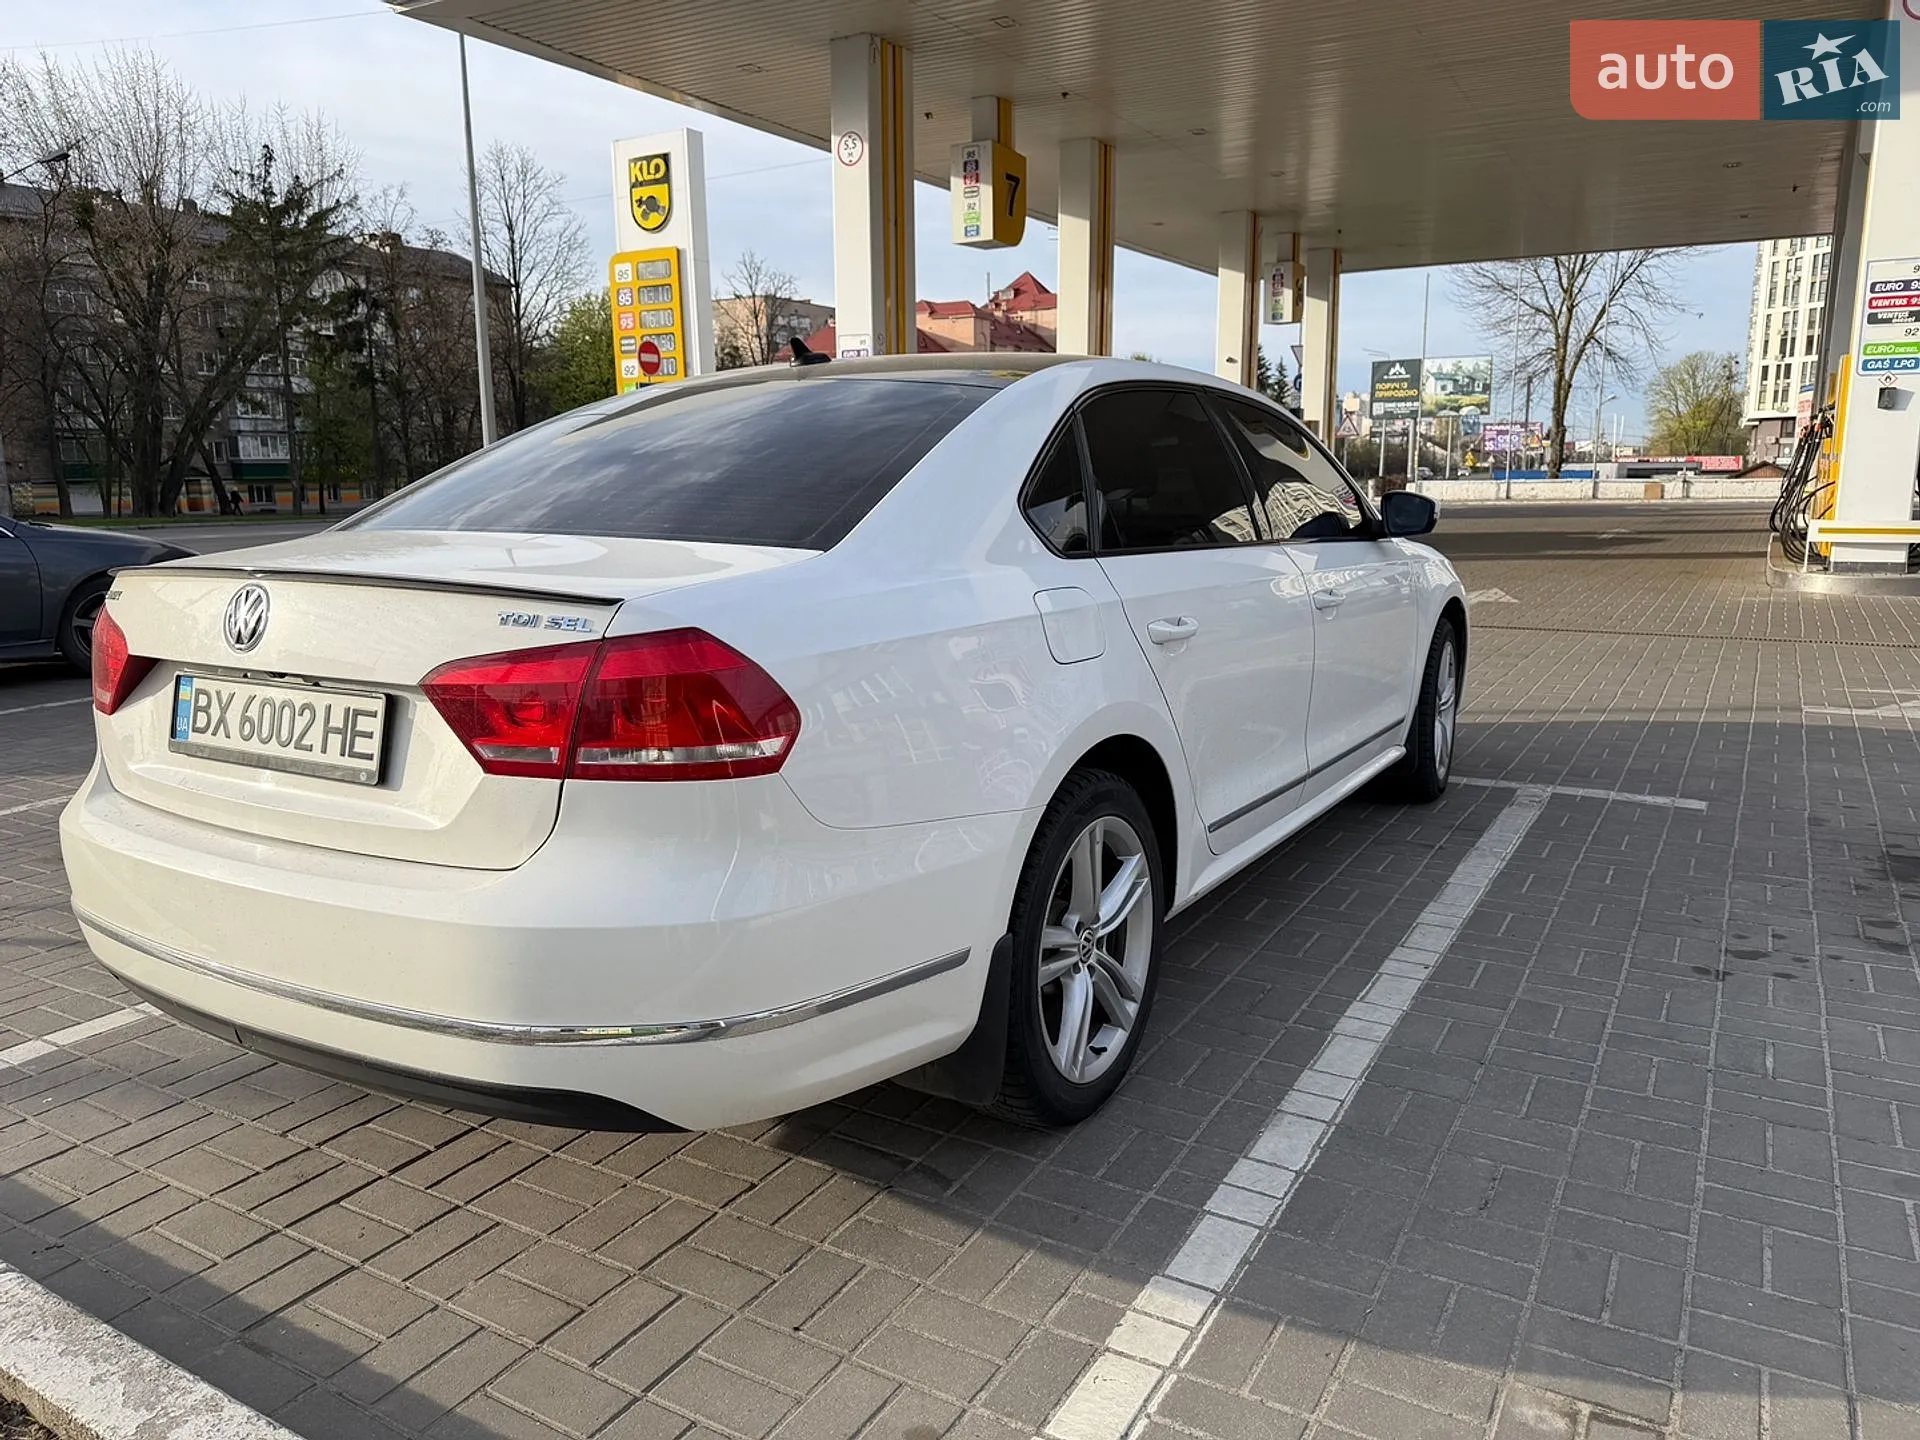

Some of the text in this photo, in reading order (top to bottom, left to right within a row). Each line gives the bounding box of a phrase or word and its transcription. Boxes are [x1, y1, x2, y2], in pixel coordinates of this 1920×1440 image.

[630, 158, 666, 183] KLO
[1005, 172, 1021, 217] 7
[618, 269, 630, 281] 95
[1875, 282, 1904, 292] EURO
[619, 294, 632, 306] 95
[1872, 298, 1908, 307] VENTUS
[621, 318, 634, 330] 95
[1904, 328, 1919, 337] 92
[1866, 345, 1894, 354] EURO
[1867, 359, 1915, 369] GAS LPG
[624, 366, 636, 376] 92
[498, 612, 591, 633] TDI SEL
[176, 715, 188, 731] UA
[192, 688, 378, 761] BX 6002 HE
